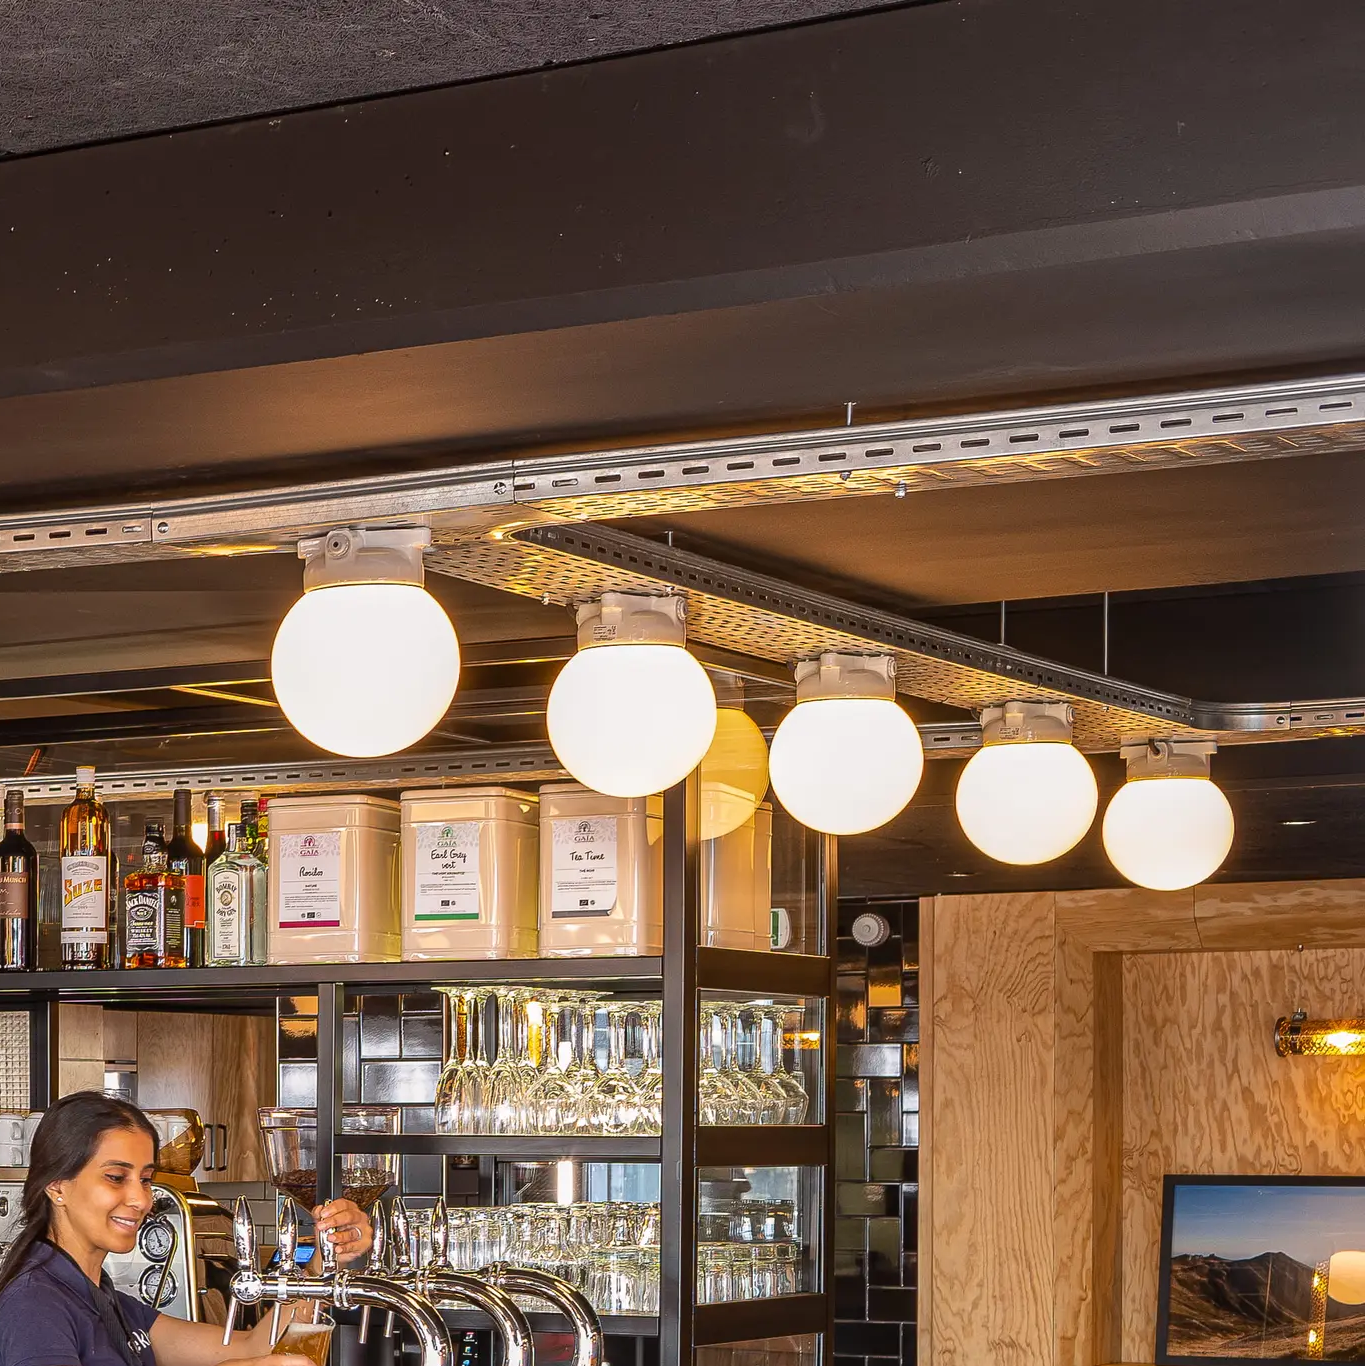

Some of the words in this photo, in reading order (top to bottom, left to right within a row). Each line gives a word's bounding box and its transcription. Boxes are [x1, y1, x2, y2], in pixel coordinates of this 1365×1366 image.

[431, 849, 447, 859] Earl
[450, 849, 466, 863] Grey
[570, 851, 583, 861] Tea
[585, 850, 605, 860] Time
